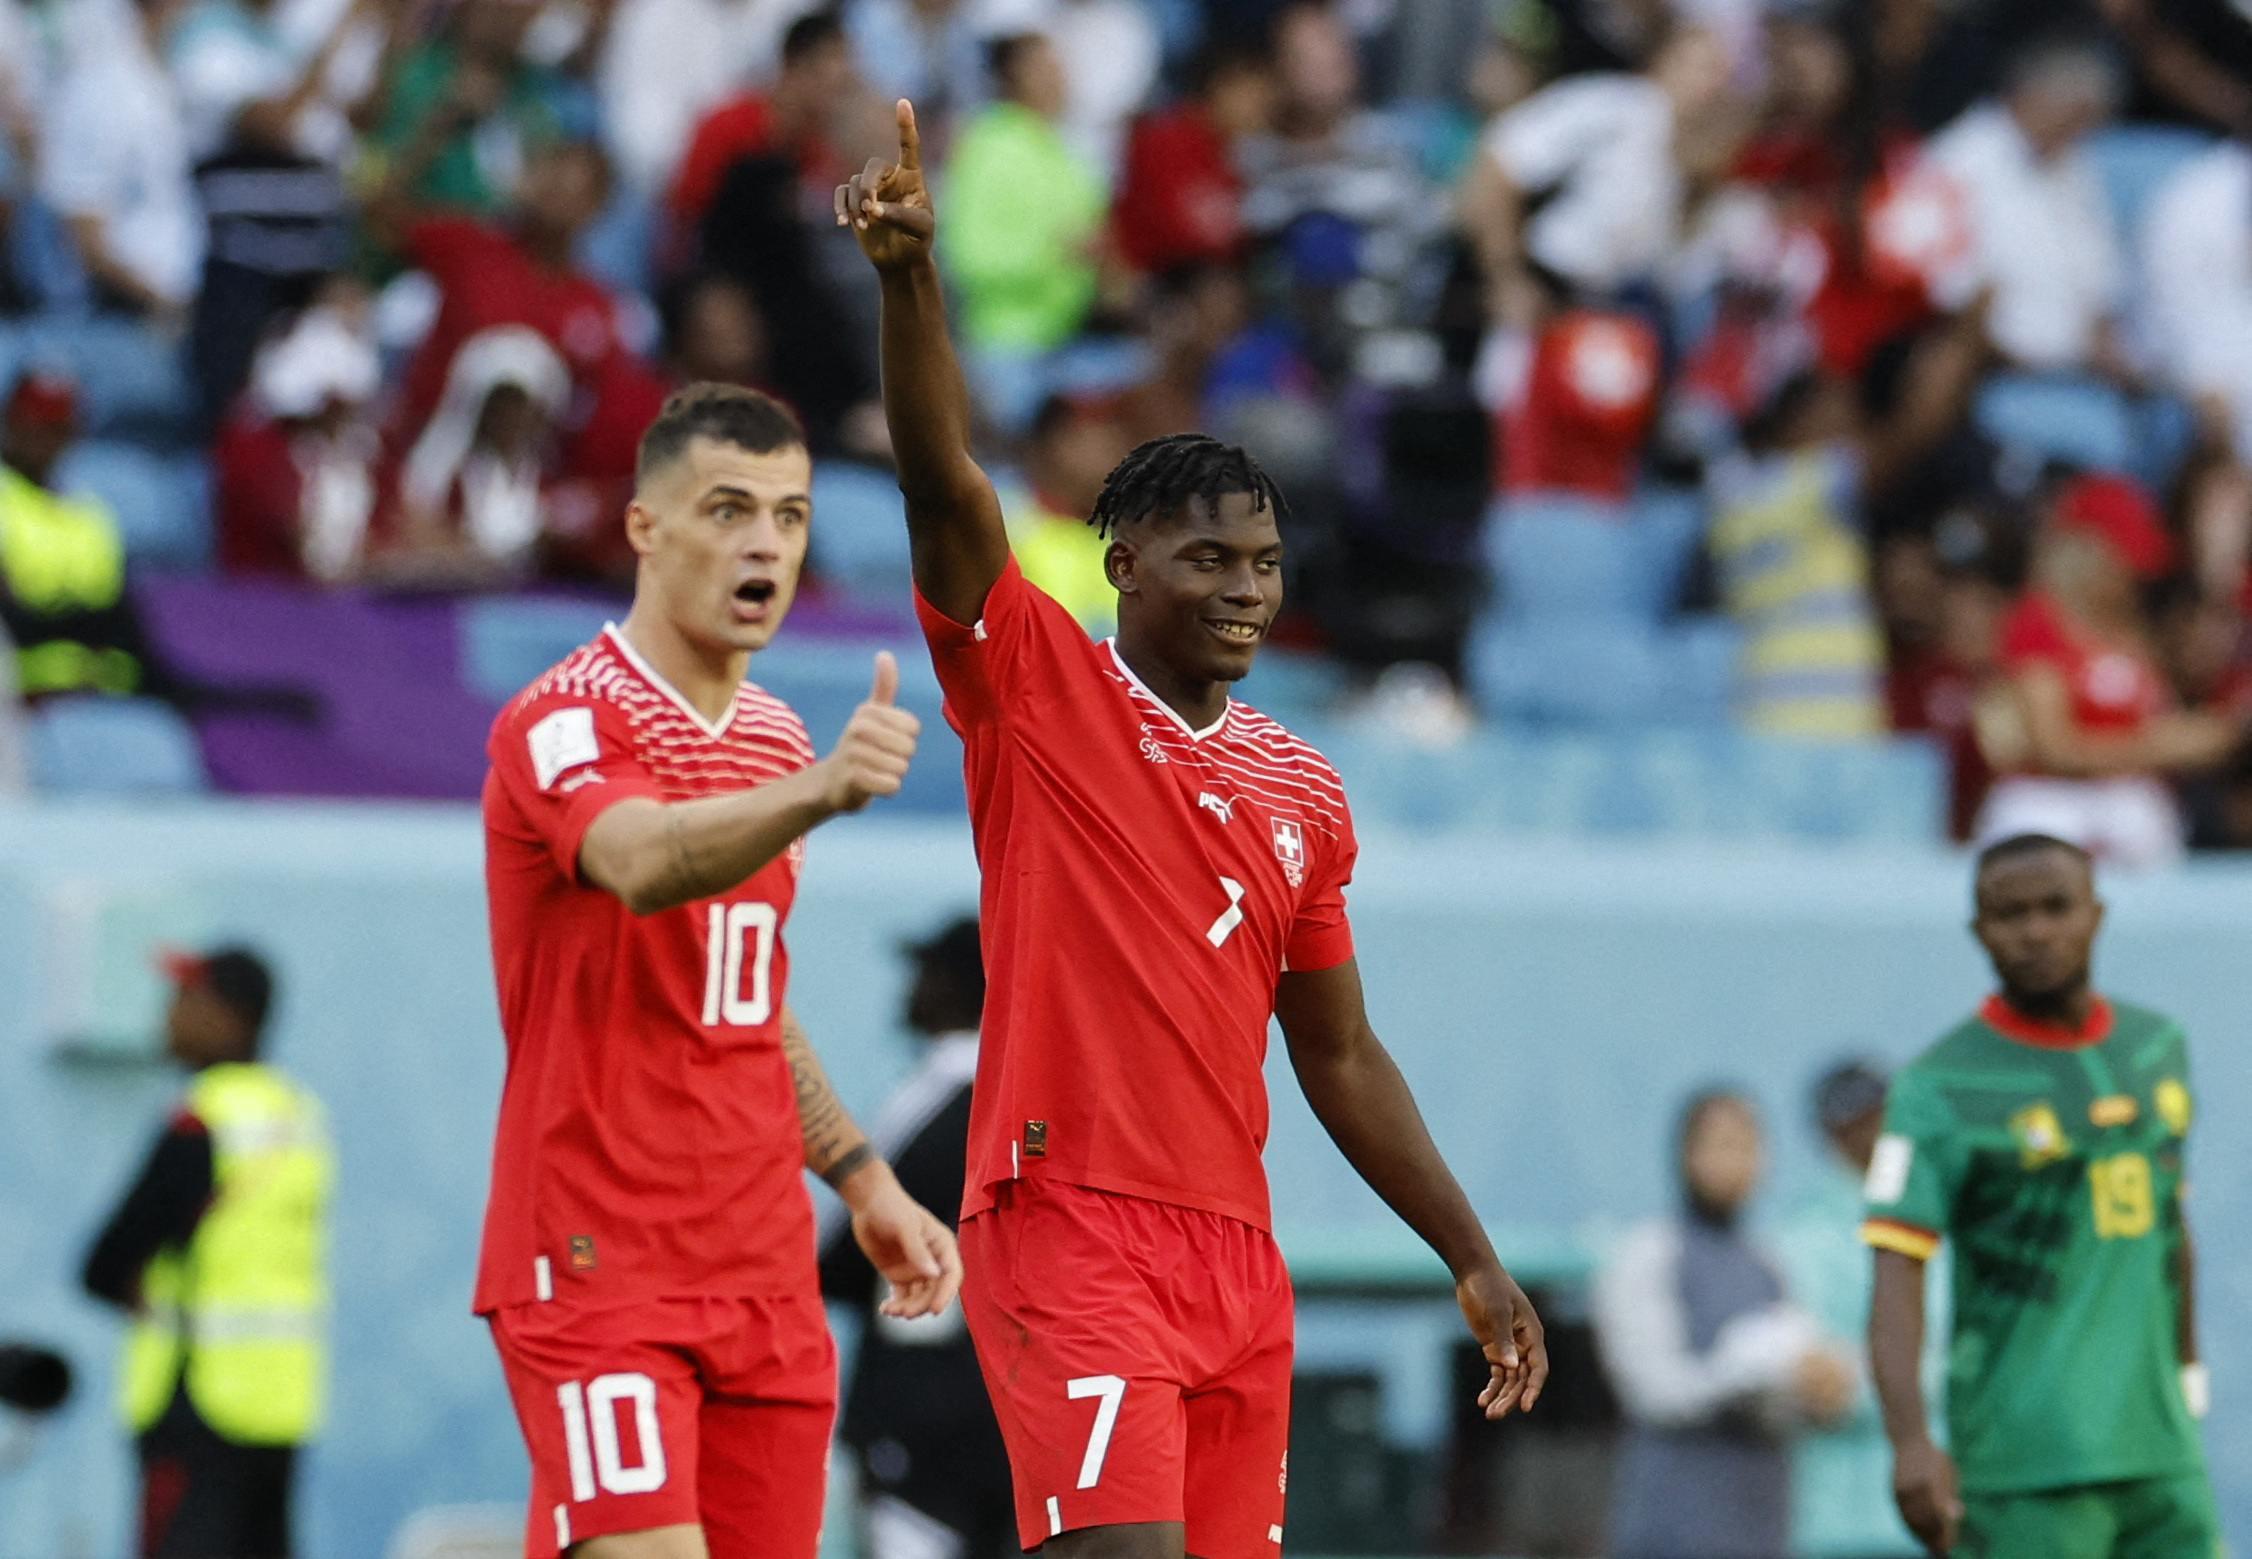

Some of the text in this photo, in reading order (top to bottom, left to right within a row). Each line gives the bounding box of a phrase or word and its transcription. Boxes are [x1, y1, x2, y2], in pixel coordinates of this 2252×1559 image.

[701, 901, 778, 1027] 10
[2090, 1153, 2155, 1239] 19
[557, 1372, 667, 1503] 10
[1066, 1374, 1127, 1490] 7
